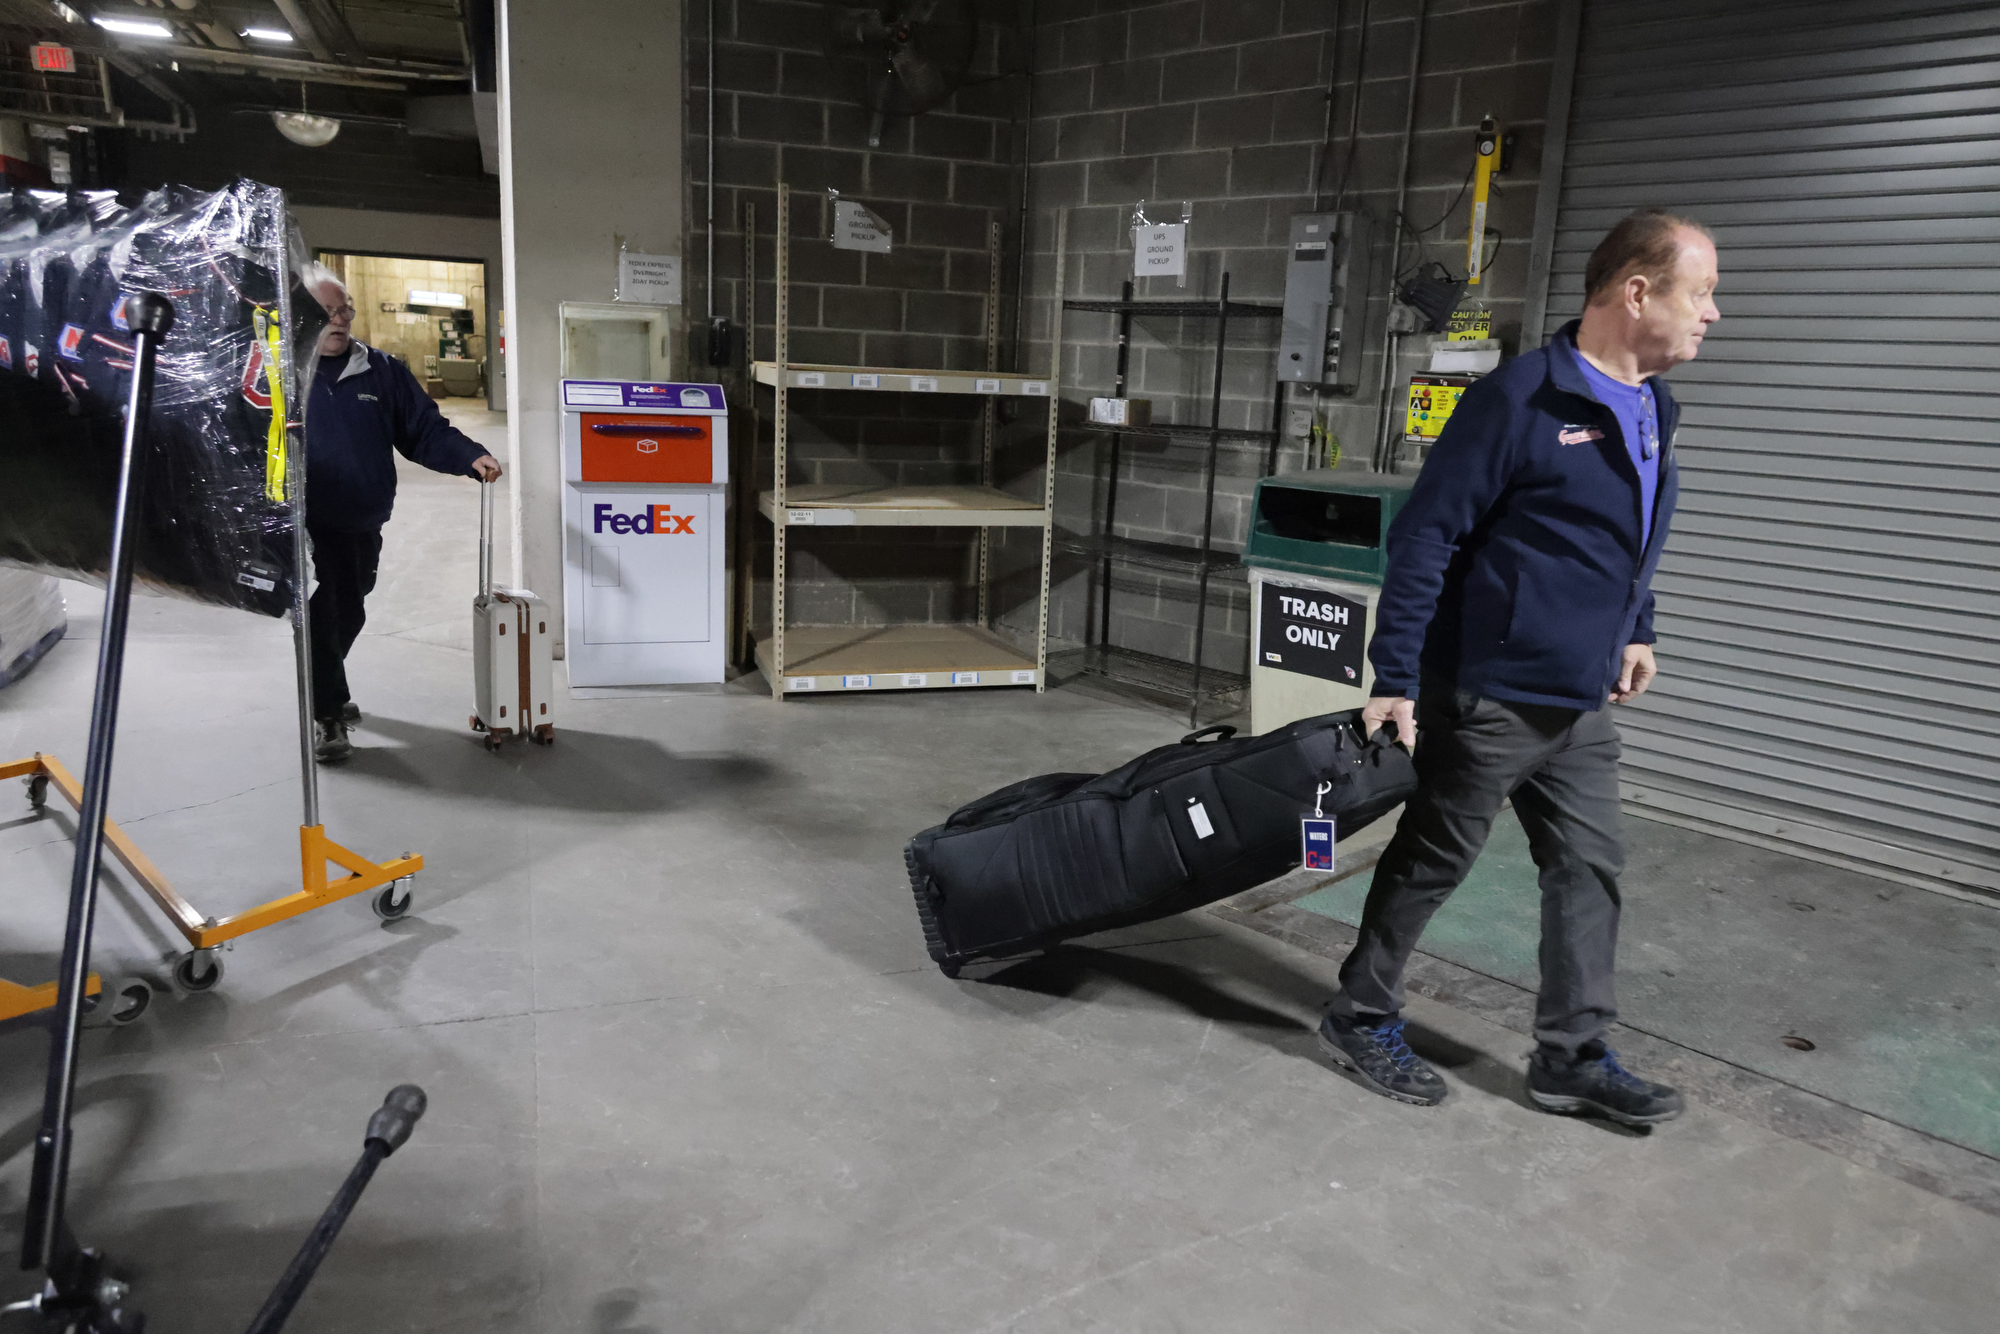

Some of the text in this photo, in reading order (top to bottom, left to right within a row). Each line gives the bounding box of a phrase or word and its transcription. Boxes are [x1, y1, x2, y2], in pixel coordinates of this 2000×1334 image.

[37, 46, 67, 69] EXIT
[848, 220, 876, 230] GROUN
[851, 232, 876, 241] PICKUP
[1146, 245, 1174, 253] GROUND
[1148, 257, 1170, 265] PICKUP
[648, 279, 670, 287] PICKUP
[632, 385, 667, 393] FedEx
[594, 503, 696, 535] FedEx
[1279, 595, 1349, 626] TRASH
[1285, 624, 1342, 651] ONLY
[1306, 850, 1318, 868] C
